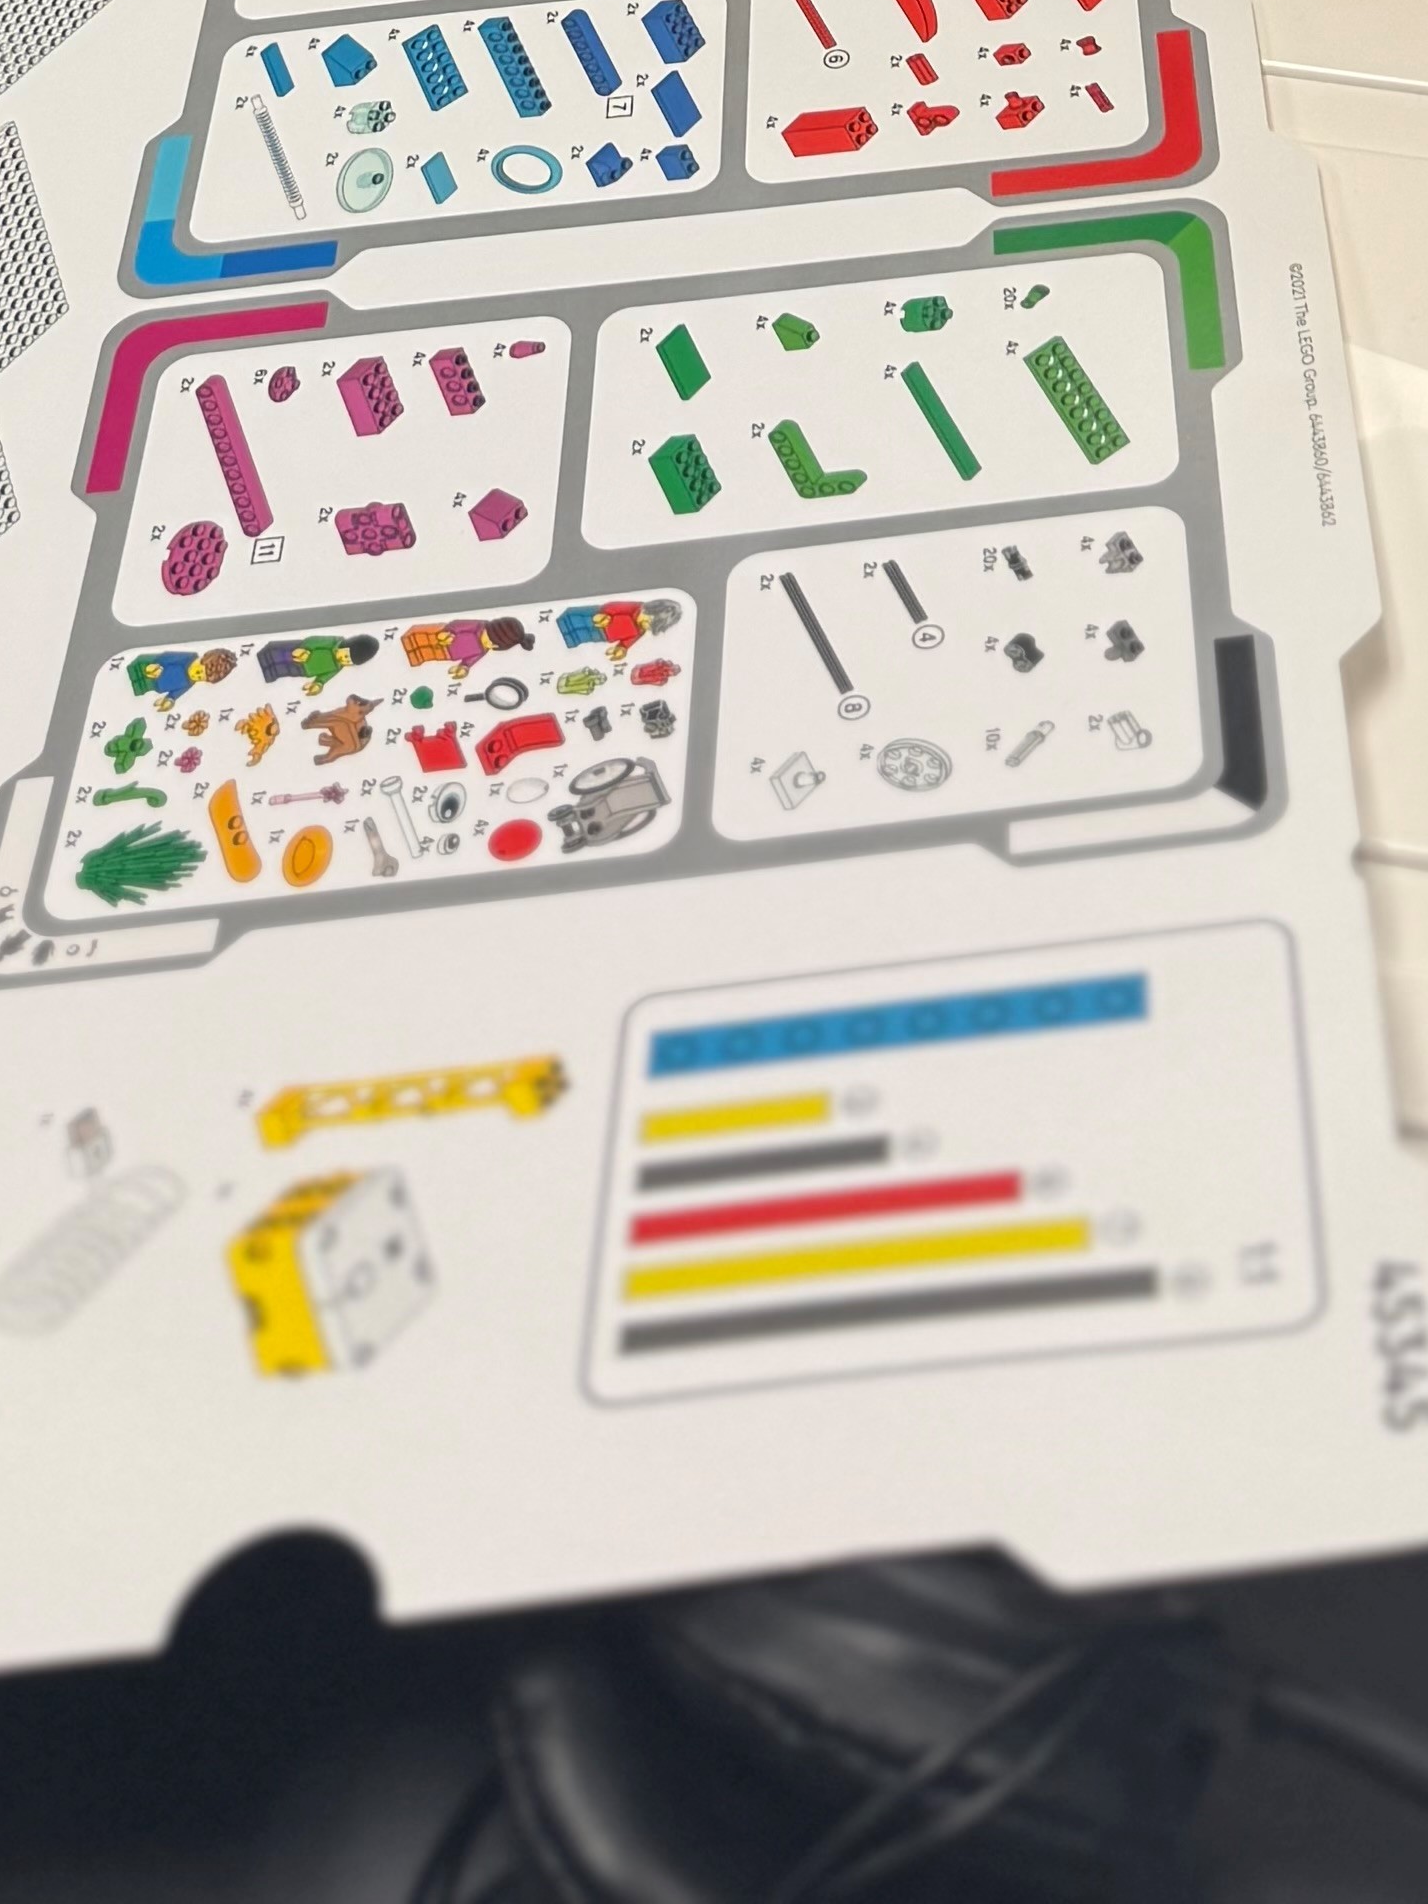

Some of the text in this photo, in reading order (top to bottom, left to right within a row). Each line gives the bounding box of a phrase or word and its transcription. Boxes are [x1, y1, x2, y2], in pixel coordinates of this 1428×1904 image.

[626, 2, 640, 16] 2x
[546, 10, 559, 25] 2x
[462, 19, 476, 33] 4x
[387, 28, 401, 41] 4x
[245, 45, 258, 58] 4x
[307, 37, 321, 51] 4x
[1059, 38, 1072, 52] 4x
[977, 46, 990, 60] 4x
[890, 54, 903, 69] 2x
[636, 73, 650, 88] 2x
[1069, 84, 1082, 98] 4x
[234, 95, 249, 110] 2x
[979, 93, 992, 108] 4x
[333, 105, 347, 119] 4x
[891, 102, 904, 117] 4x
[765, 115, 779, 130] 4x
[325, 151, 339, 167] 2x
[476, 148, 490, 163] 4x
[570, 145, 585, 160] 2x
[639, 147, 653, 162] 4x
[405, 154, 420, 169] 2x
[1002, 286, 1017, 311] 20x
[883, 300, 897, 316] 4x
[1294, 302, 1309, 327] The
[755, 315, 769, 331] 4x
[639, 327, 654, 344] 2x
[492, 342, 507, 359] 4x
[1005, 340, 1019, 356] 4x
[1297, 328, 1317, 366] LEGO
[411, 351, 427, 368] 4x
[321, 360, 336, 377] 2x
[883, 364, 898, 380] 4x
[253, 369, 268, 385] 6x
[179, 377, 195, 394] 2x
[1303, 368, 1319, 412] Group.
[751, 422, 766, 439] 2x
[631, 439, 646, 456] 2x
[452, 491, 467, 509] 4x
[317, 506, 334, 524] 2x
[150, 524, 167, 542] 2x
[1080, 535, 1095, 552] 4x
[982, 547, 998, 573] 20x
[863, 561, 878, 579] 2x
[759, 573, 775, 592] 2x
[1084, 623, 1100, 640] 4x
[984, 635, 1000, 653] 4x
[1087, 713, 1104, 733] 2x
[985, 727, 1001, 752] 10x
[859, 743, 875, 761] 4x
[750, 756, 766, 774] 4x
